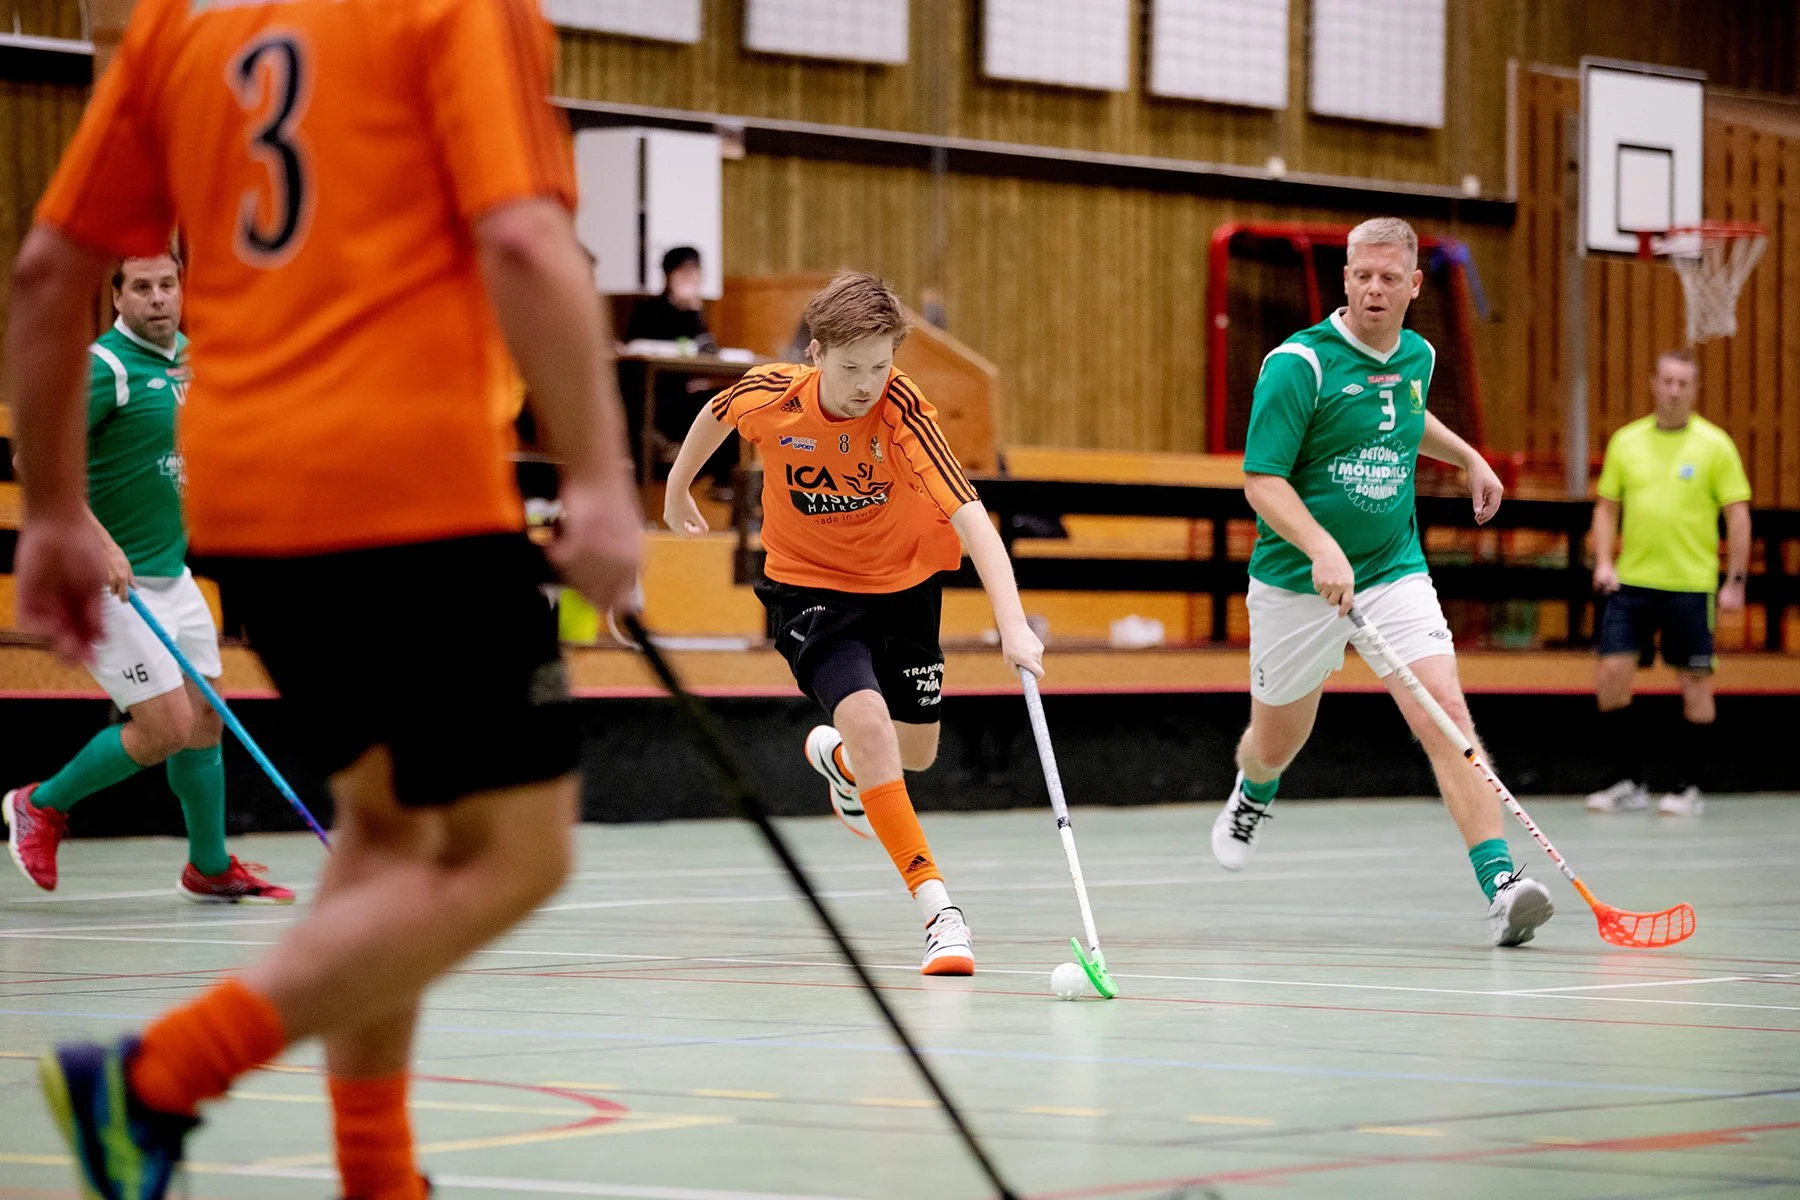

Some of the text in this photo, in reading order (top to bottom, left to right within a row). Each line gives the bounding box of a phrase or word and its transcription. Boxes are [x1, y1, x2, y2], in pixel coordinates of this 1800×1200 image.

[226, 28, 315, 267] 3
[1378, 390, 1396, 431] 3
[794, 443, 814, 451] SPORT
[839, 433, 850, 455] 8
[1359, 446, 1399, 463] BETONG
[786, 464, 838, 491] ICA
[857, 463, 874, 480] SJ
[1338, 460, 1408, 479] MÖLNDALS
[122, 663, 149, 686] 46
